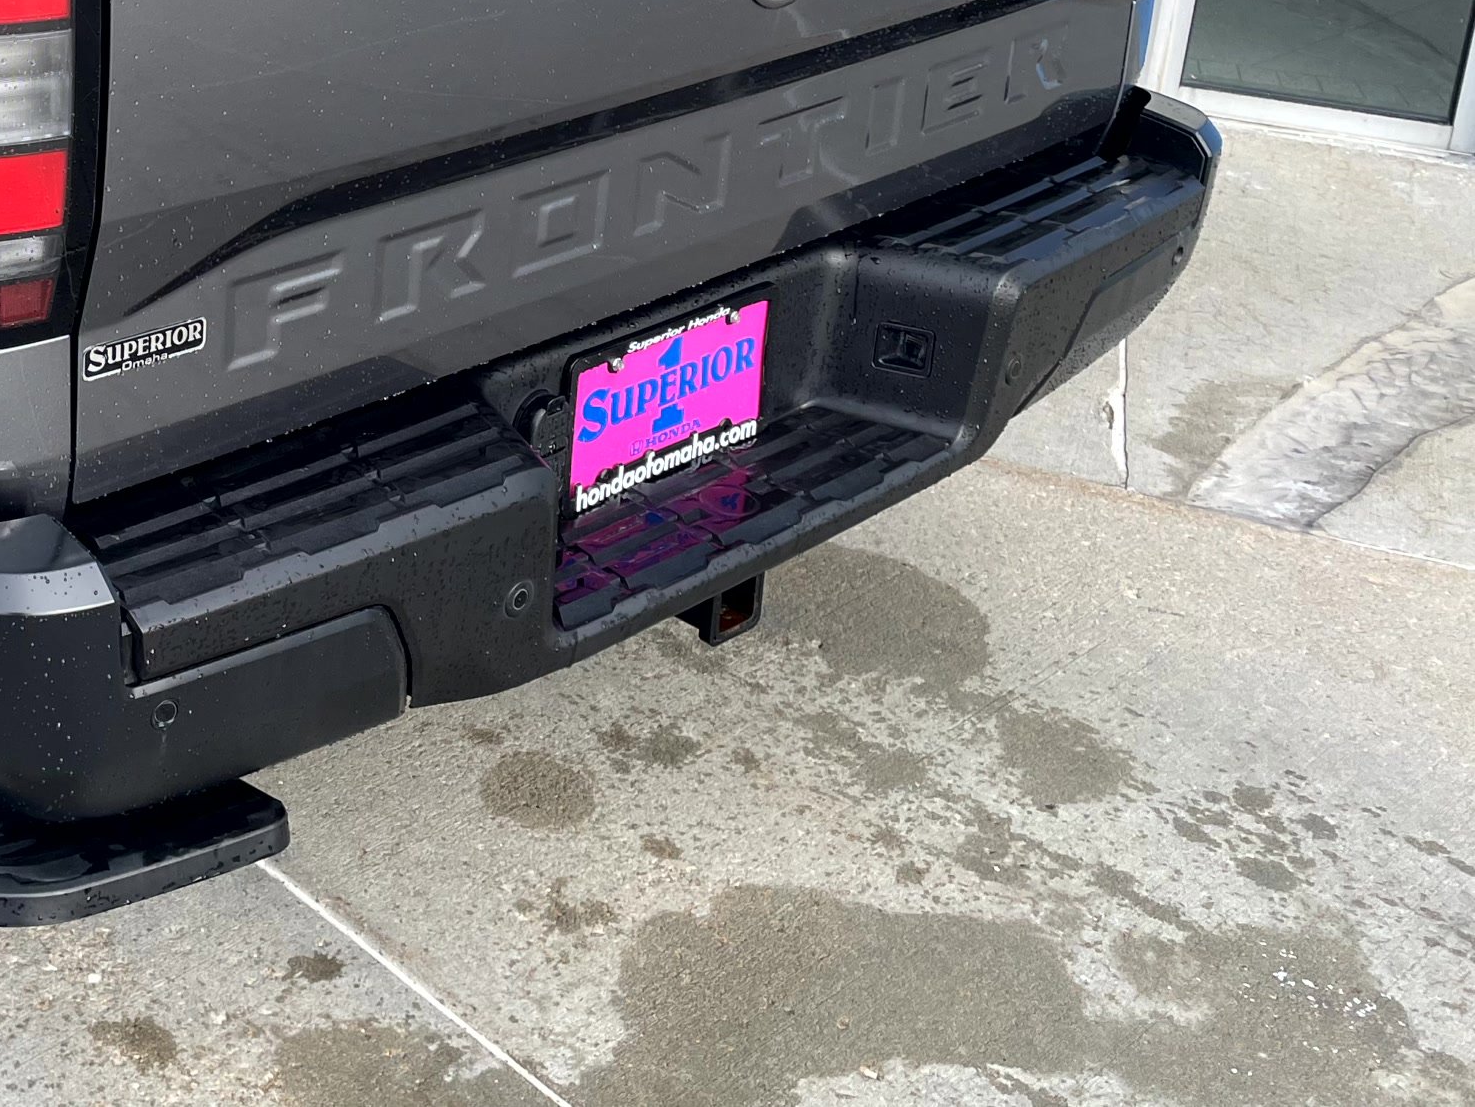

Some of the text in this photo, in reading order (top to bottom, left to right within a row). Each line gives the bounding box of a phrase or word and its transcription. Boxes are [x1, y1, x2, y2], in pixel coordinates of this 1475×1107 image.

[226, 19, 1072, 372] FRONTIER
[627, 306, 731, 354] Superior Honda
[121, 352, 168, 371] Omaha
[645, 419, 701, 447] HONDA
[575, 418, 758, 513] hondaofomaha.com
